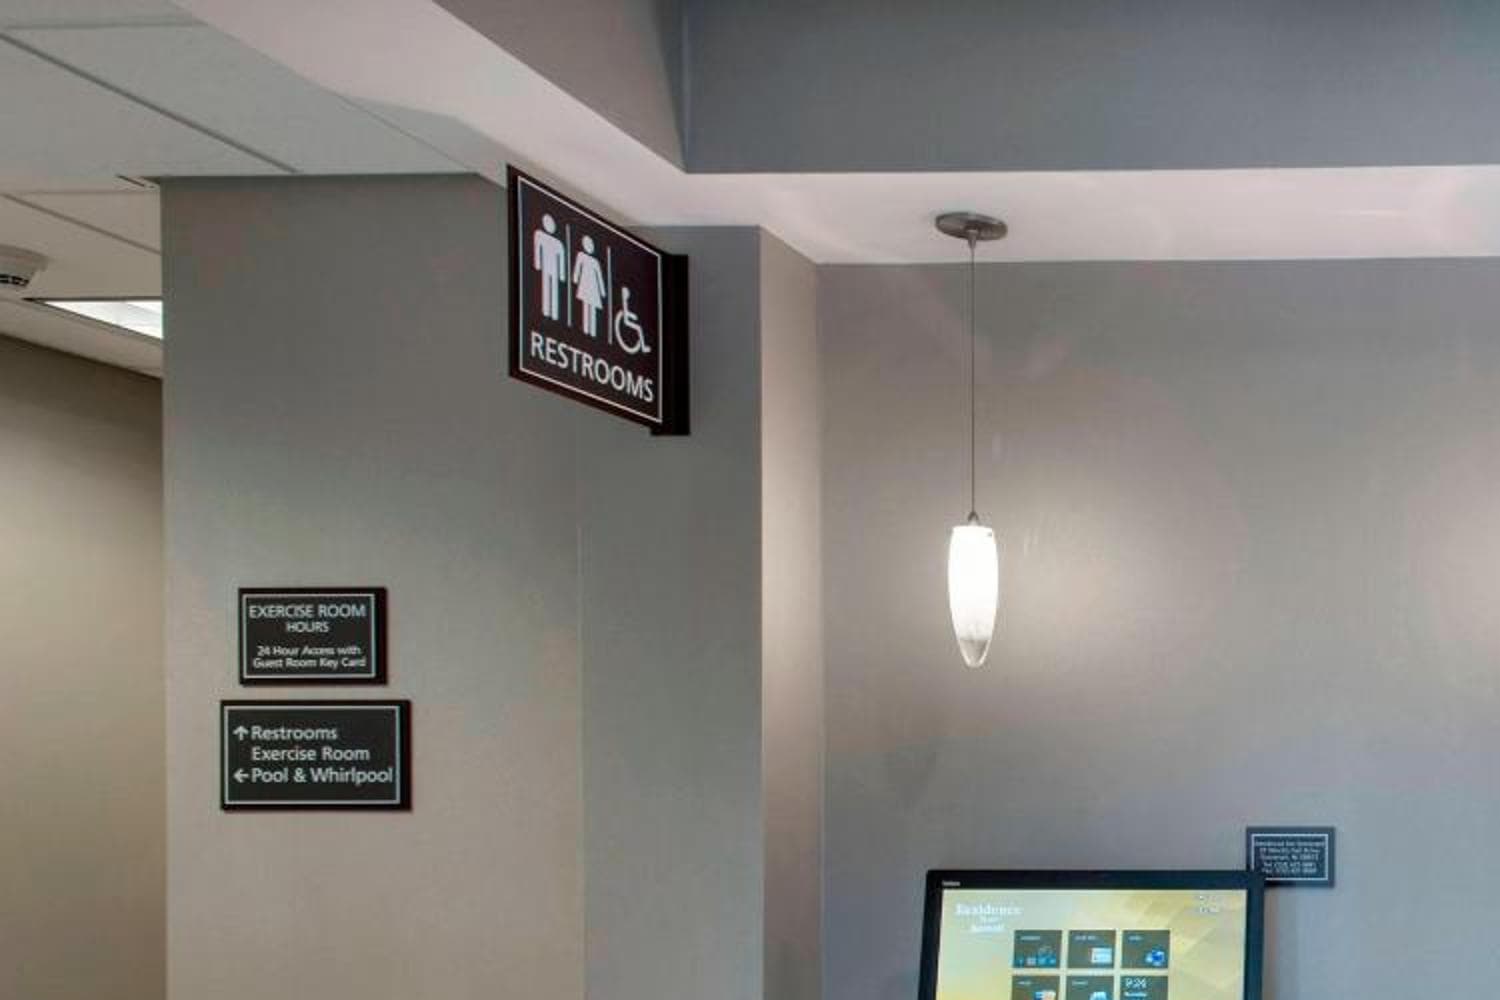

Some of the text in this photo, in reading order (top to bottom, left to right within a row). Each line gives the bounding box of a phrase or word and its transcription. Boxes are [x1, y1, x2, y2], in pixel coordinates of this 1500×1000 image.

[530, 331, 654, 402] RESTROOMS
[249, 604, 366, 618] EXERCISE ROOM
[286, 621, 329, 633] HOURS
[256, 645, 361, 656] 24 Hour Access with
[253, 657, 366, 670] Guest Room Key Card
[251, 725, 337, 740] Restrooms
[252, 746, 370, 761] Exercise Room
[251, 767, 393, 787] Pool & Whirlpool
